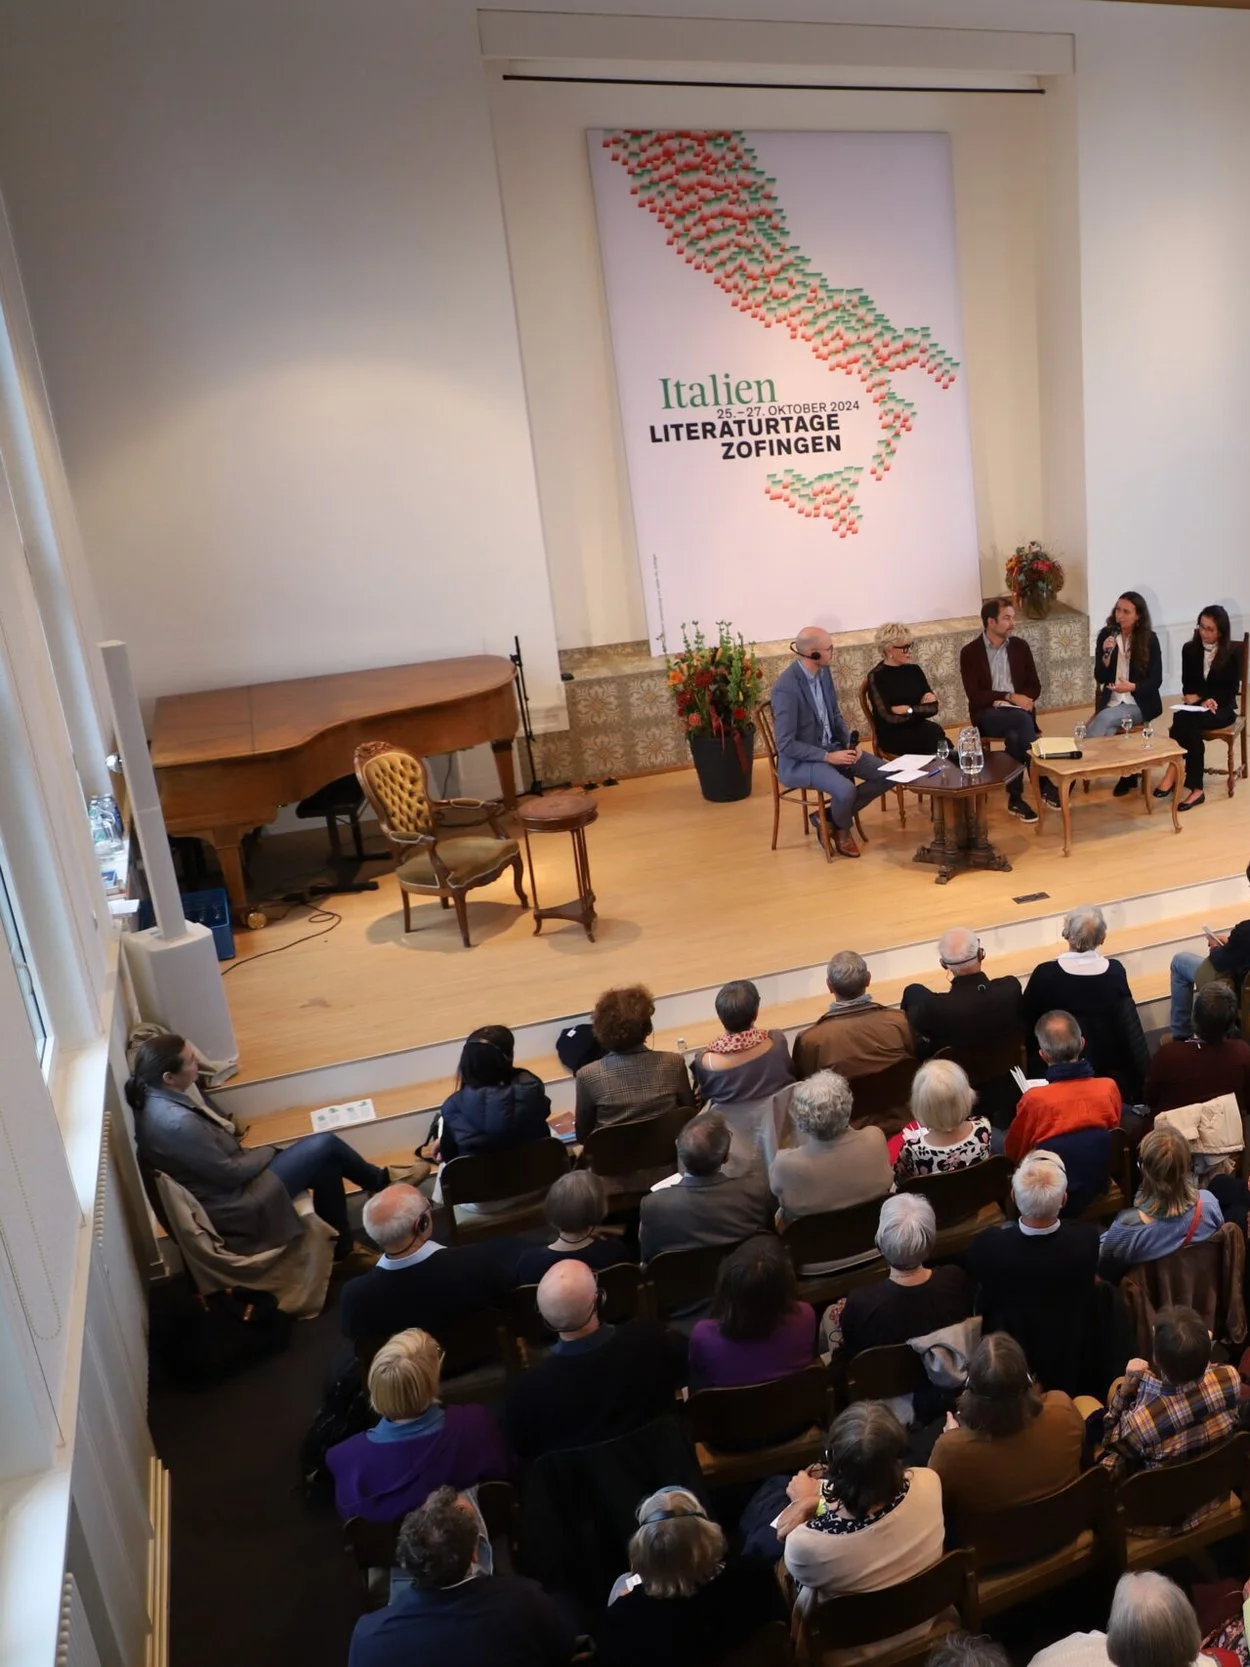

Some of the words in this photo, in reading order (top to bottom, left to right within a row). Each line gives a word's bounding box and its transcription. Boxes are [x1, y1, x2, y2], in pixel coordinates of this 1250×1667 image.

[658, 373, 778, 409] Italien
[768, 402, 827, 416] OKTOBER
[830, 400, 860, 412] 2024
[650, 413, 840, 443] LITERATURTAGE
[721, 434, 841, 460] ZOFINGEN
